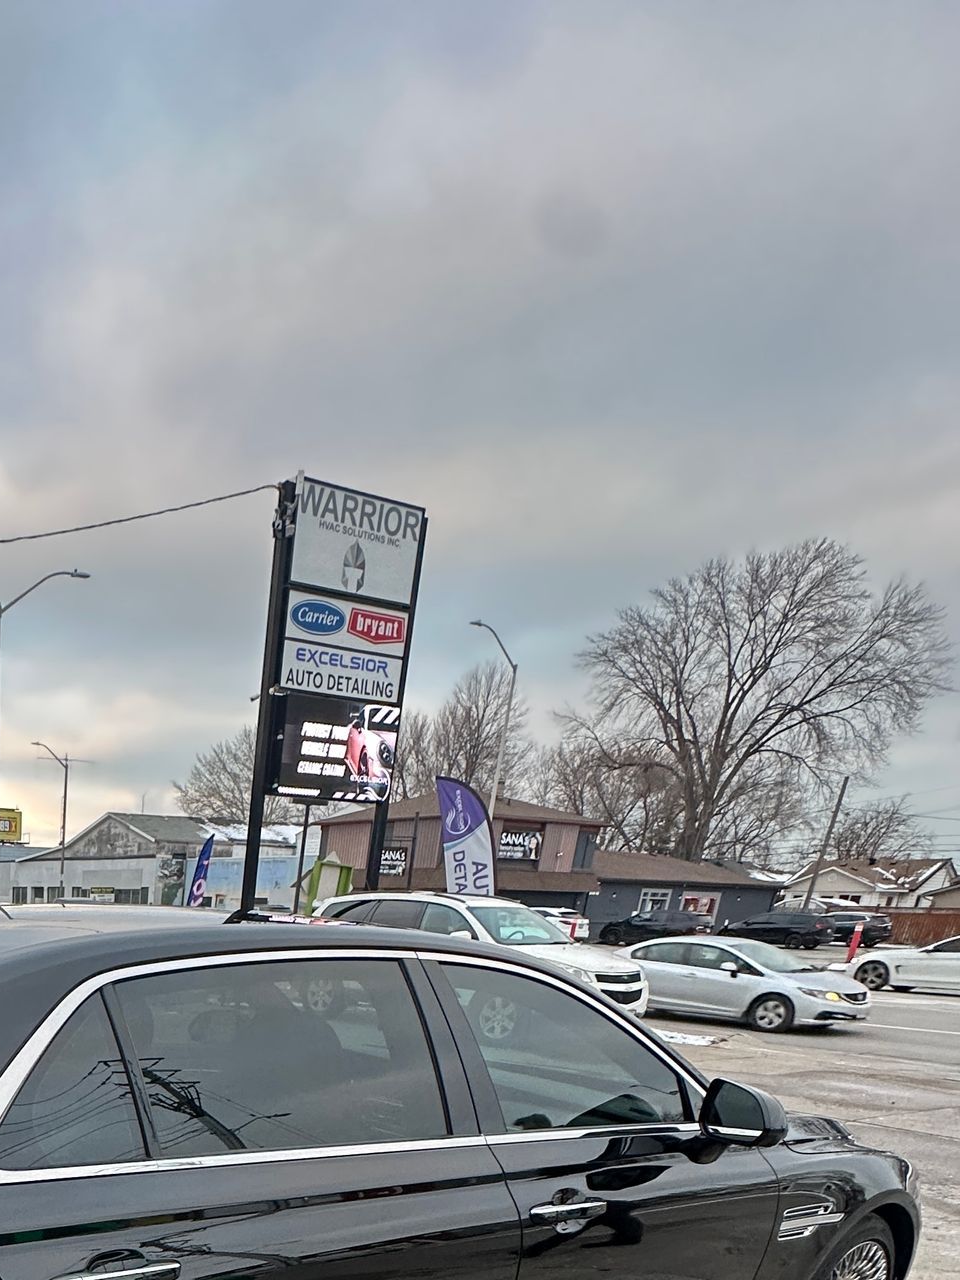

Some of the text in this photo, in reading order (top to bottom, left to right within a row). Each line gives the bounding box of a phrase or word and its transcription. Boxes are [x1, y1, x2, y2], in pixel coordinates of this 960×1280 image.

[300, 484, 419, 542] WARRIOR
[319, 519, 340, 533] HVAC
[342, 525, 385, 544] SOLUTIONS
[298, 607, 340, 626] Carrier
[356, 614, 399, 638] bryant
[296, 647, 388, 678] EXCELSIOR
[286, 667, 394, 699] AUTO DETAILING
